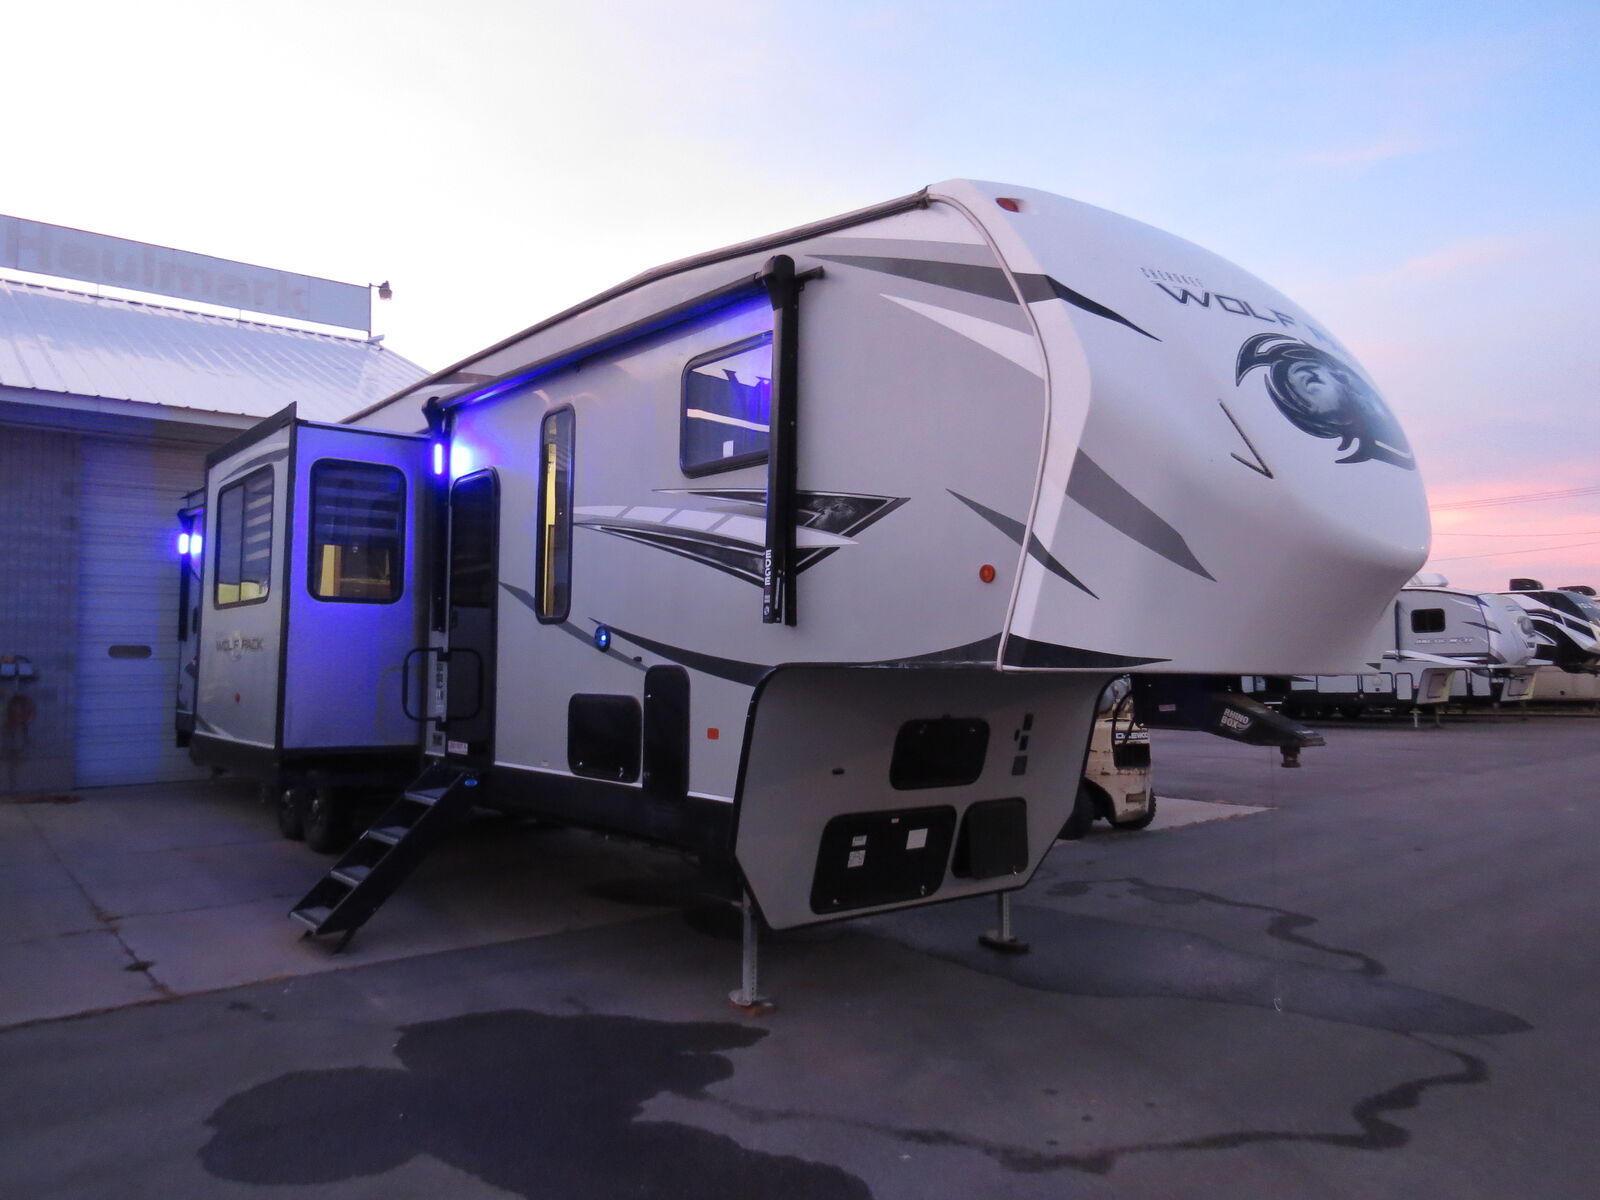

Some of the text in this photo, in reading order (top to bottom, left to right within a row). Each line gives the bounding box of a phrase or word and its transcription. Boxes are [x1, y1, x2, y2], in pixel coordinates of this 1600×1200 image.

[1152, 281, 1296, 328] WOLF
[764, 549, 772, 586] EDGE
[1221, 715, 1238, 729] BOX
[1223, 708, 1249, 724] RHINO
